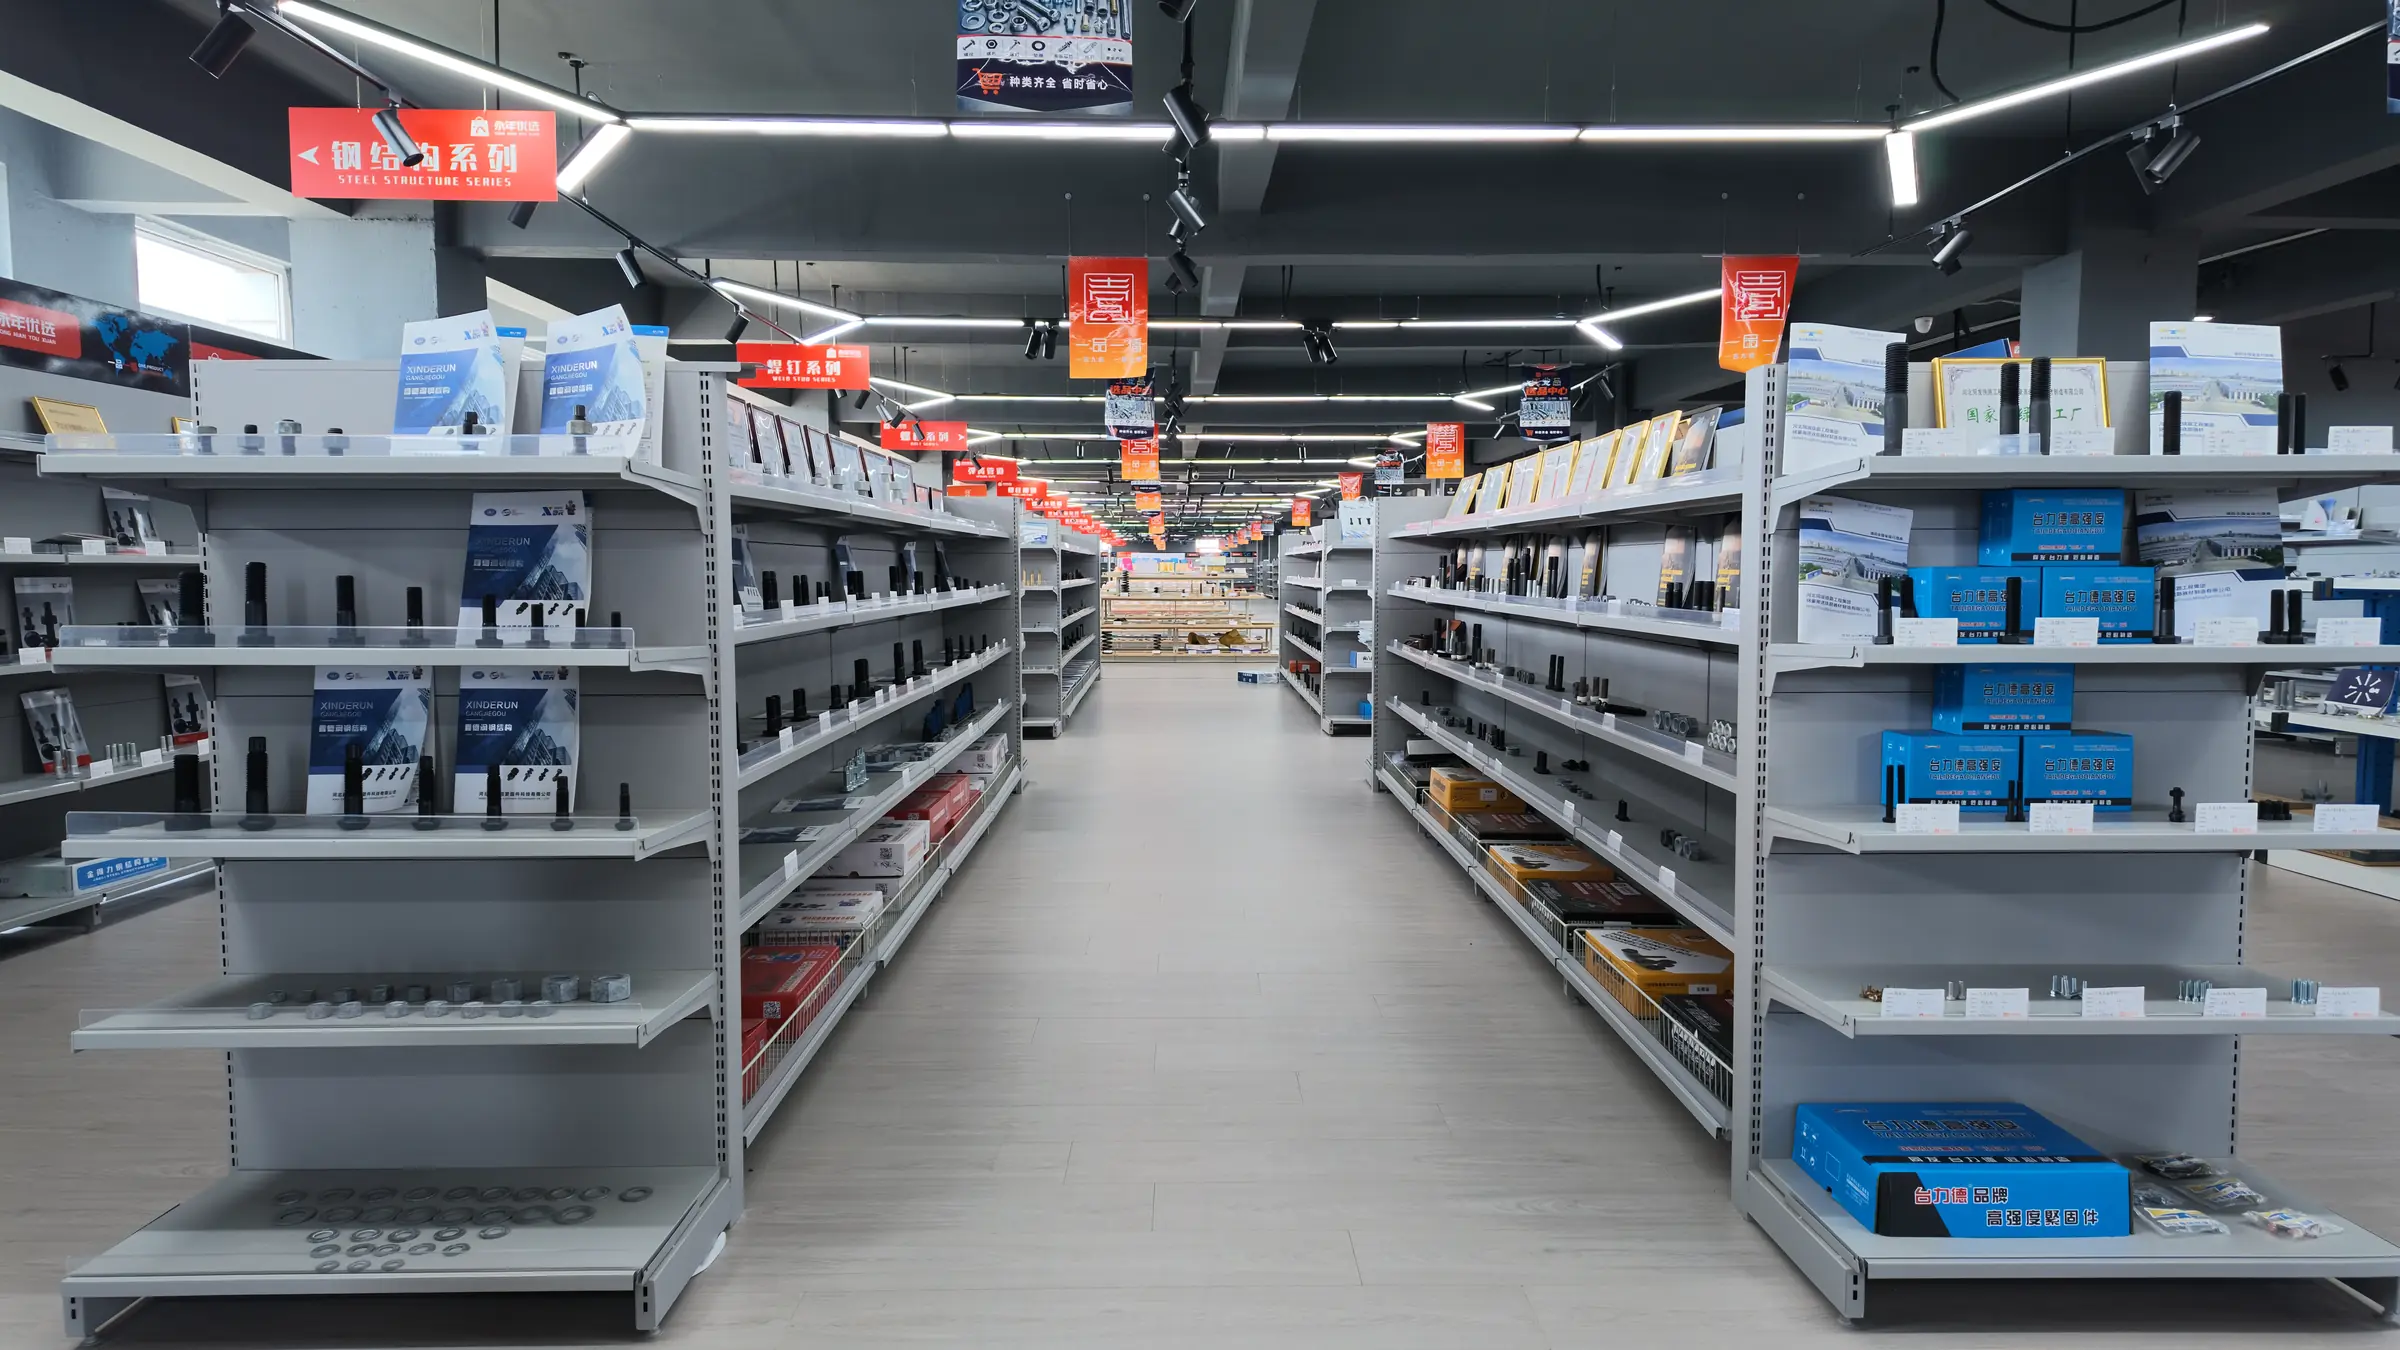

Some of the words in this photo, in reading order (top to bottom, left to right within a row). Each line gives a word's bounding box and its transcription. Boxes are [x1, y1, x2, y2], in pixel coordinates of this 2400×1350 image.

[1009, 76, 1056, 89] 种类齐全
[1062, 76, 1108, 90] 省时省心
[331, 140, 517, 174] 钢结构系列
[338, 174, 378, 185] STEEL
[384, 175, 460, 186] STRUCTURE
[466, 177, 512, 188] SERIES
[0, 311, 57, 338] 永年优选
[28, 334, 41, 342] YOU
[42, 337, 57, 345] XUAN
[407, 363, 457, 374] XINDERUN
[551, 361, 598, 373] XINDERUN
[1526, 386, 1568, 396] 选品中心
[1966, 405, 2082, 423] 国家绿工厂
[900, 430, 949, 442] 螺系列
[2033, 511, 2105, 527] 台力德高强度
[2065, 589, 2137, 604] 台力德高强度
[1983, 683, 2056, 697] 台力德高强度
[320, 701, 374, 711] XINDERUN
[465, 701, 519, 709] XINDERUN
[1929, 758, 2001, 772] 台力德高强度
[2045, 758, 2115, 772] 台力德高强度
[1914, 1186, 1969, 1205] 台力德
[1973, 1187, 2009, 1204] 品牌
